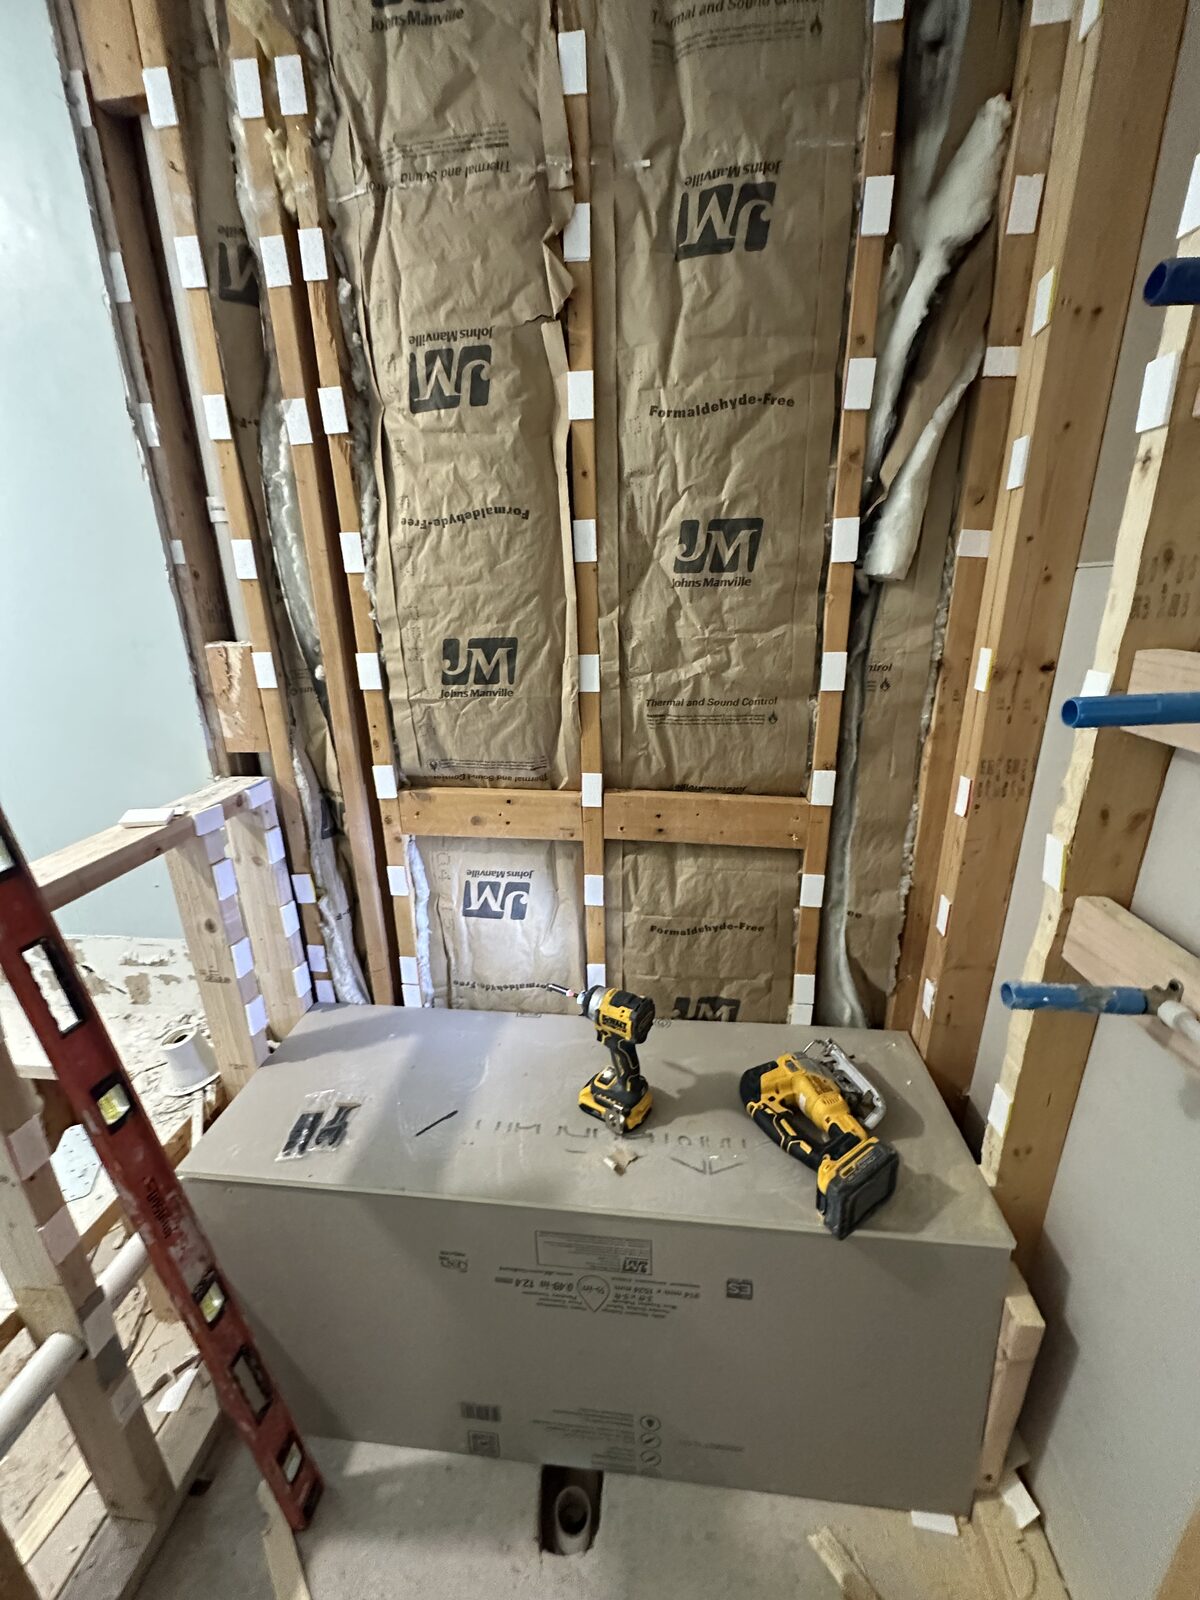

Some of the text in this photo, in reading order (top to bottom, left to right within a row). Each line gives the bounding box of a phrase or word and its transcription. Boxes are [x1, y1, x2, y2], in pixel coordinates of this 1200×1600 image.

[400, 169, 437, 183] Sound
[440, 167, 461, 180] and
[464, 161, 511, 178] Thermal
[684, 160, 783, 187] Johns Manville
[676, 181, 777, 260] JM
[408, 325, 495, 347] Johns Manville
[409, 344, 492, 415] JM
[649, 393, 796, 419] Formaldehyde-Free
[401, 505, 531, 530] Formaldehyde-Free
[673, 517, 765, 574] JM
[671, 576, 752, 589] Johns Manville
[441, 637, 519, 686] JM
[439, 687, 514, 700] Johns Manville
[645, 696, 778, 708] Thermal and Sound Control
[466, 869, 535, 879] Johns Manville
[462, 880, 531, 921] JM
[650, 922, 766, 936] Formaldehyde-Free
